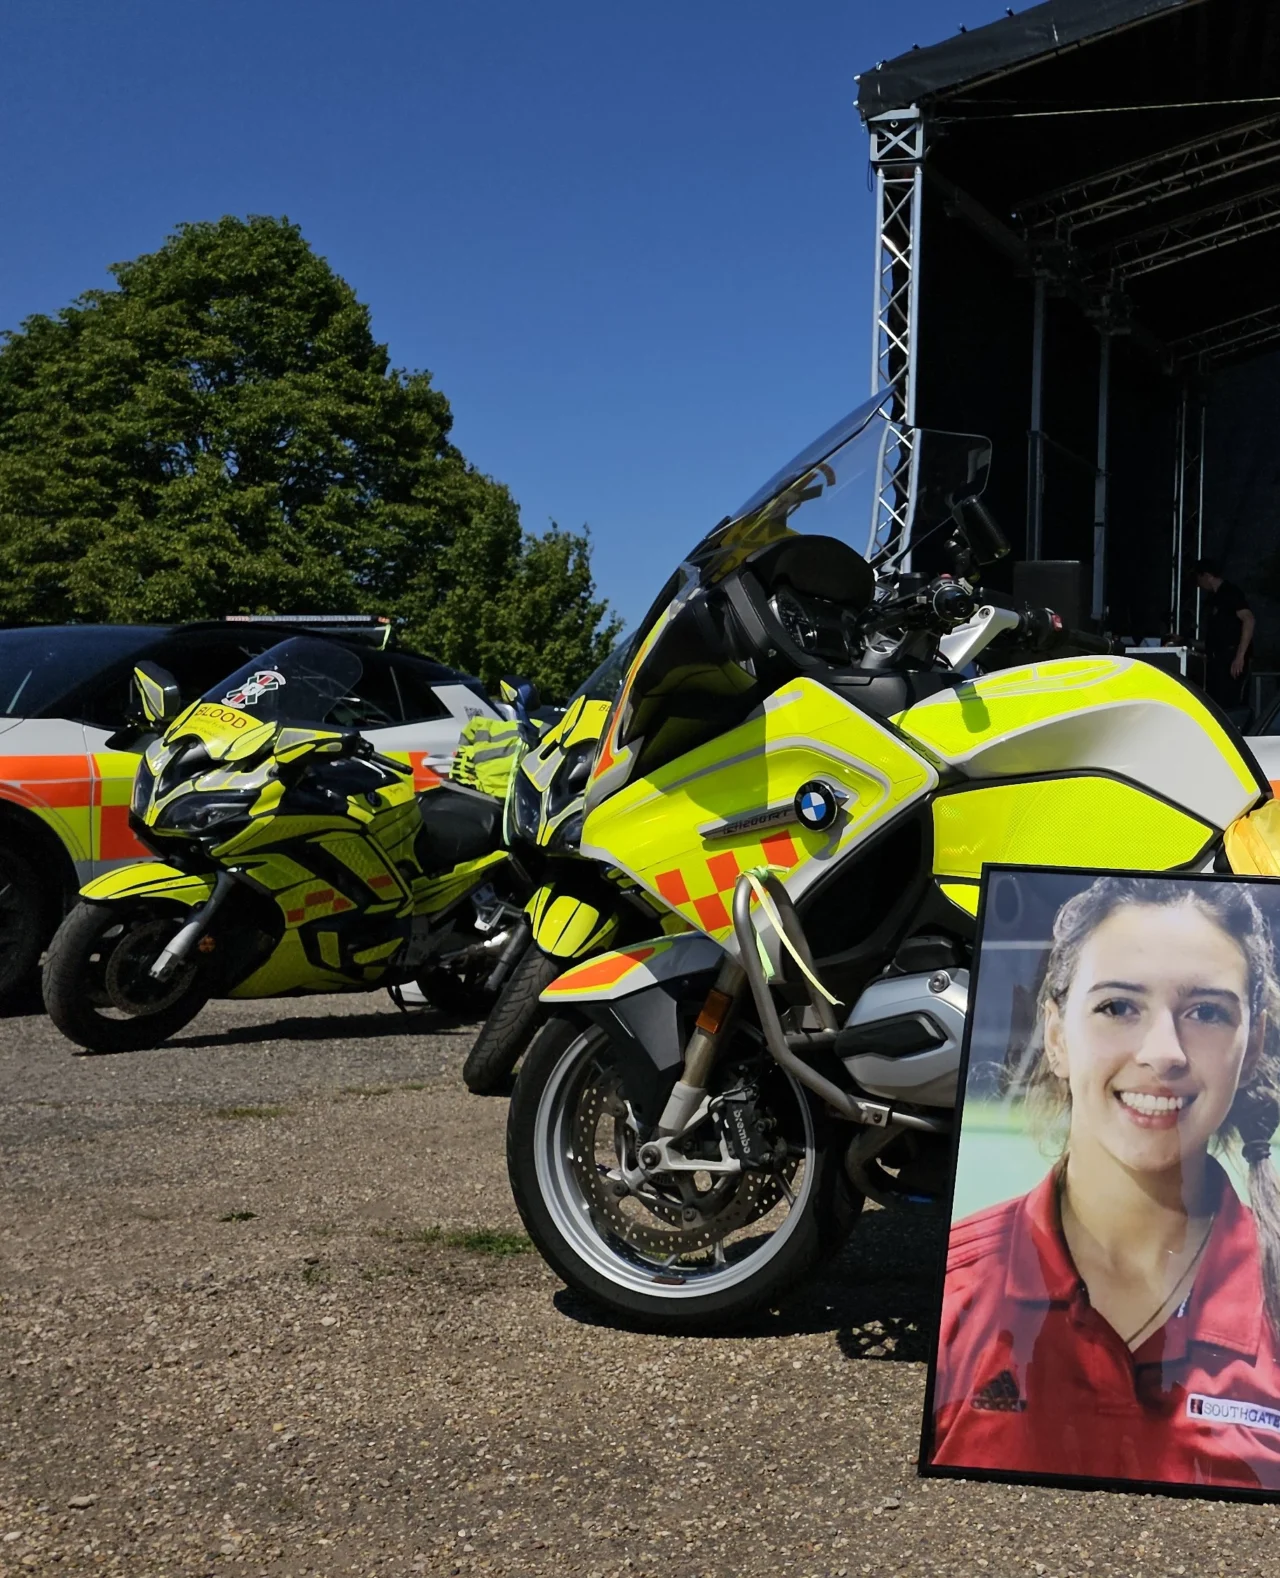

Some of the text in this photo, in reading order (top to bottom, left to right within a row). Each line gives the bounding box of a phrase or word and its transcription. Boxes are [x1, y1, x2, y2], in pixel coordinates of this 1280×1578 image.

[194, 706, 247, 729] BLOOD
[733, 1109, 750, 1154] brembo
[1203, 1402, 1280, 1428] SOUTHGATE
